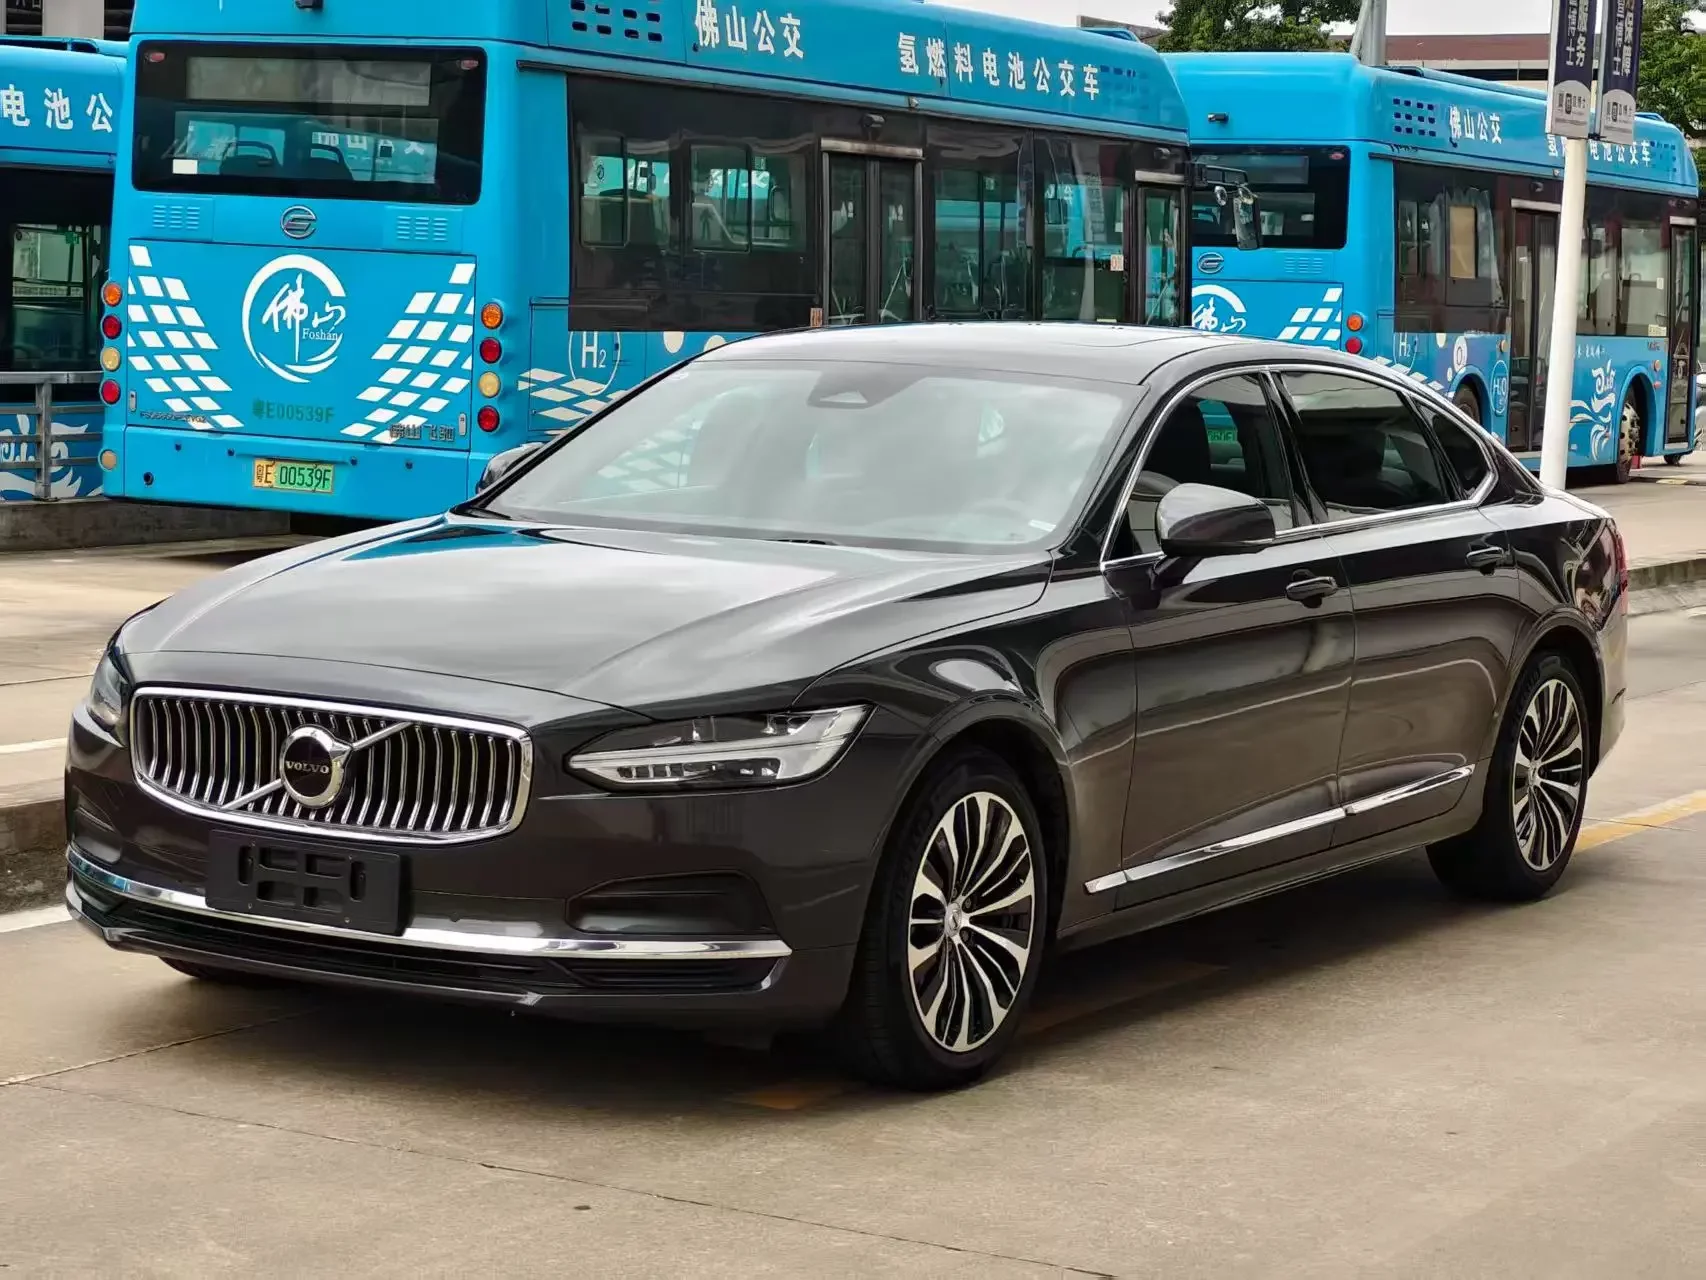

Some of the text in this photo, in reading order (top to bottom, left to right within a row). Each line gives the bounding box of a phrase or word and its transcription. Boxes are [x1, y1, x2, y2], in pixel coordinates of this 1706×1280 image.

[695, 0, 804, 59] 佛山公交
[898, 32, 1100, 100] 氢燃料电池公交车
[0, 84, 113, 133] 电池公
[1450, 105, 1502, 144] 佛山公交
[302, 328, 338, 341] Foshan
[279, 465, 332, 489] 00539F
[285, 760, 330, 774] VOLVO
